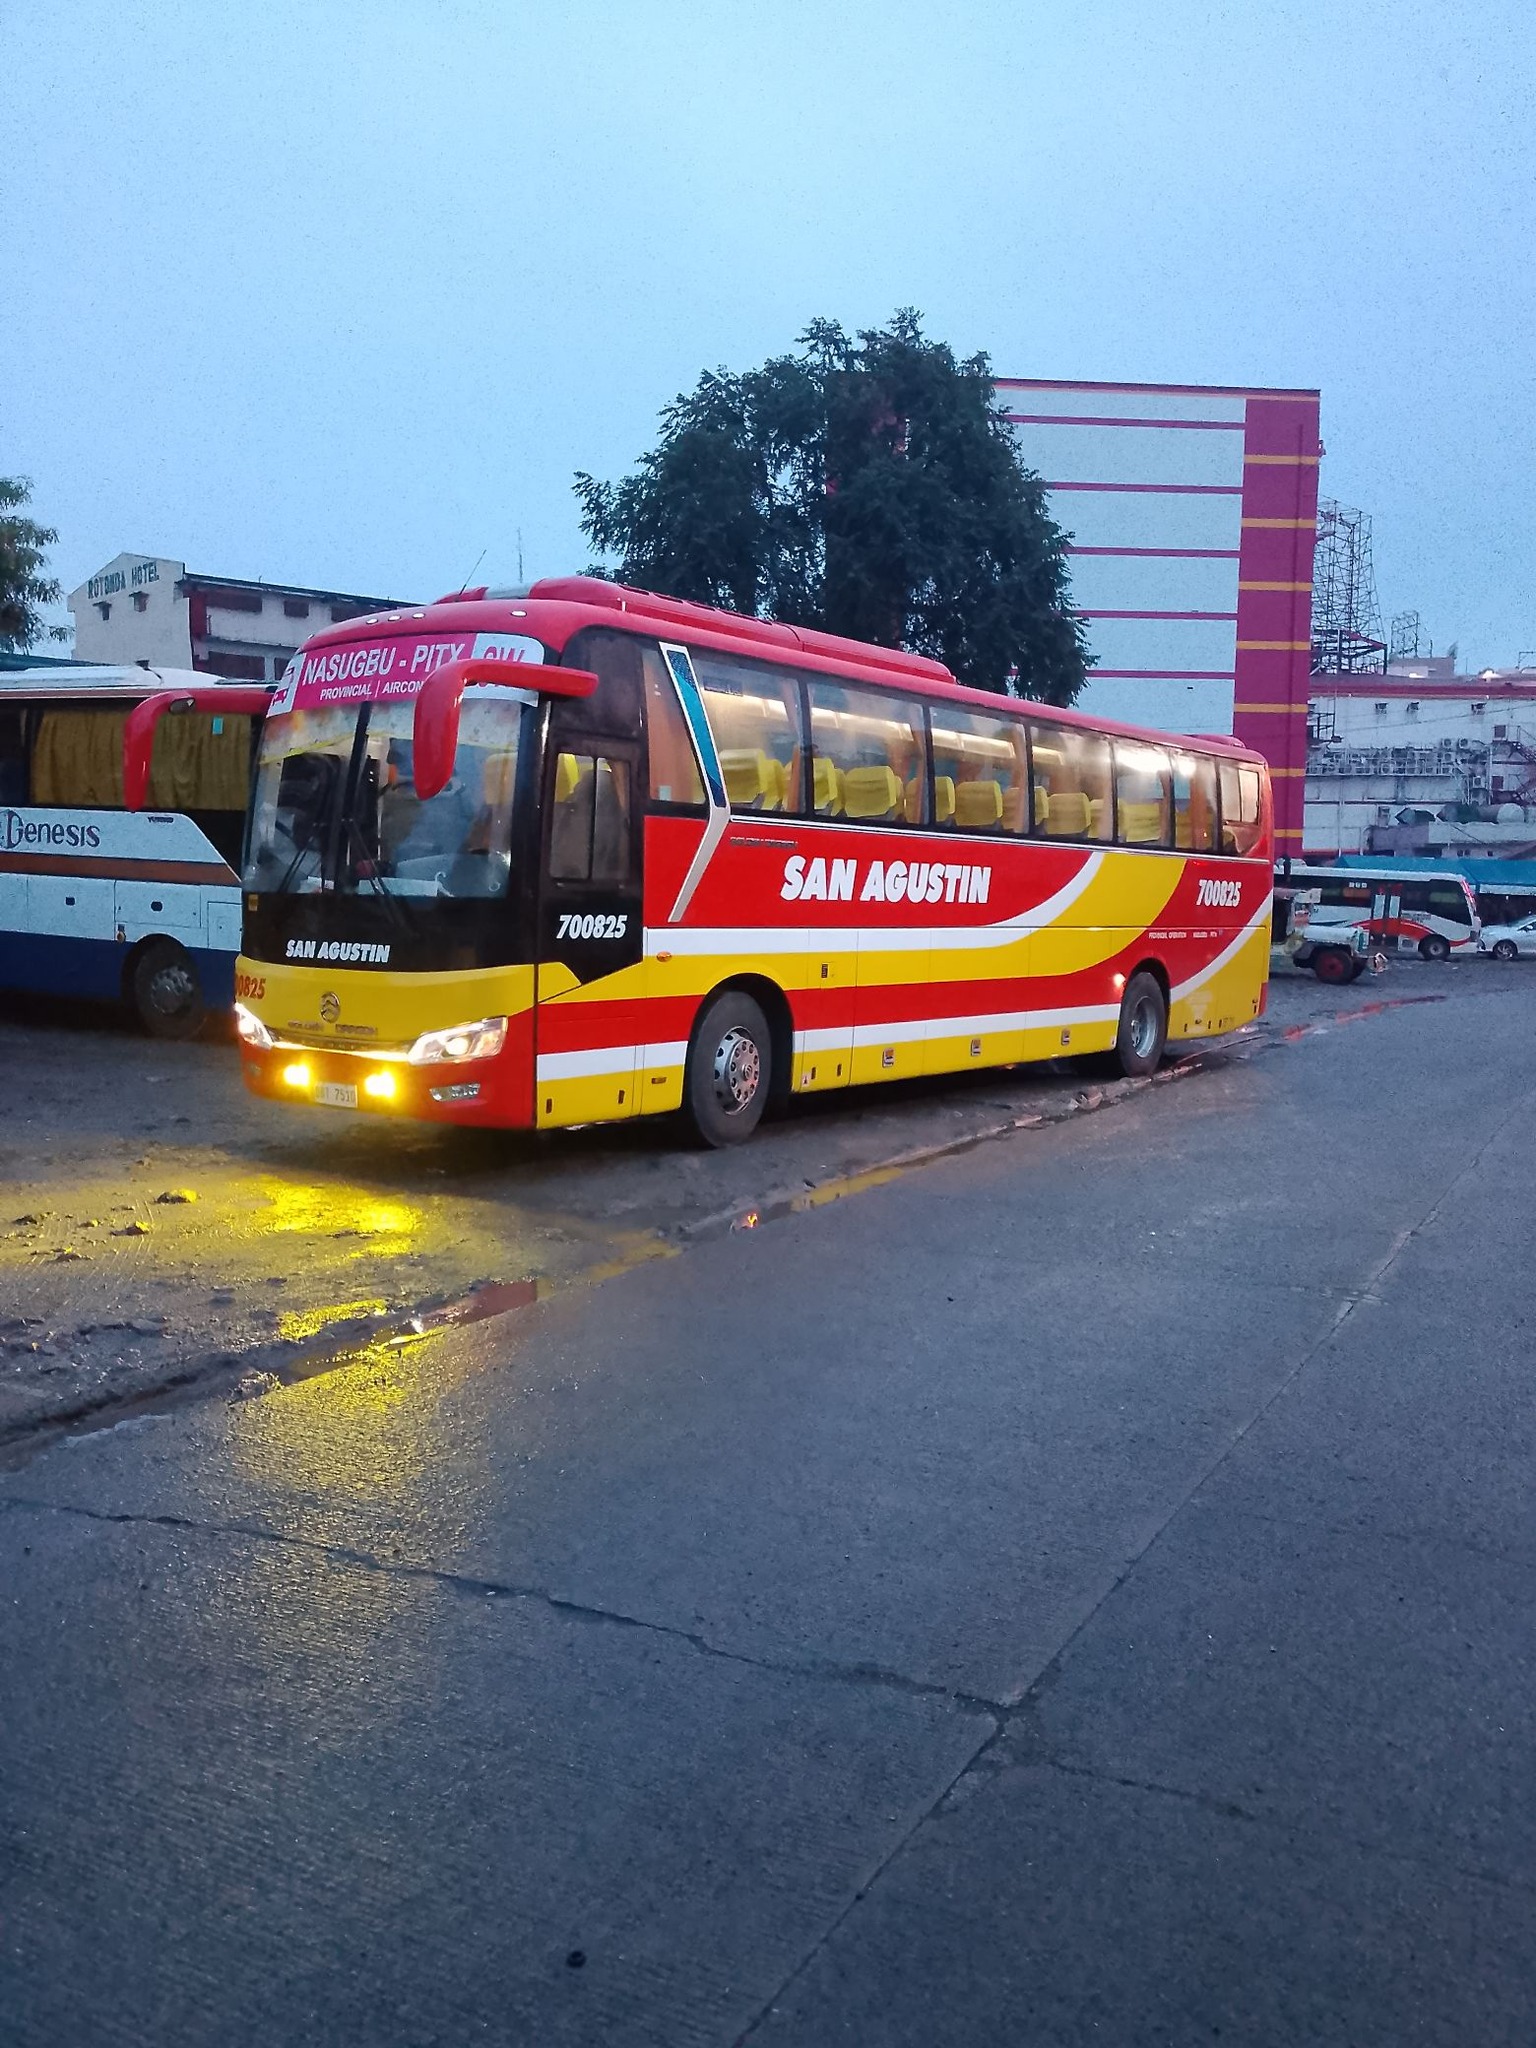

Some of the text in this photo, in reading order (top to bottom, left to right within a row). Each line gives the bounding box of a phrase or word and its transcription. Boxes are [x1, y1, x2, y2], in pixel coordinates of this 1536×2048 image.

[88, 561, 160, 599] ROTONDA HOTEL
[302, 646, 397, 686] NASUGBU
[320, 680, 425, 701] PROVINCIAL AIRCON
[7, 810, 101, 848] Genesis
[780, 855, 992, 904] SAN AGUSTIN
[1196, 879, 1242, 907] 700825
[556, 914, 628, 939] 700825
[285, 939, 391, 963] SAN AGUSTIN
